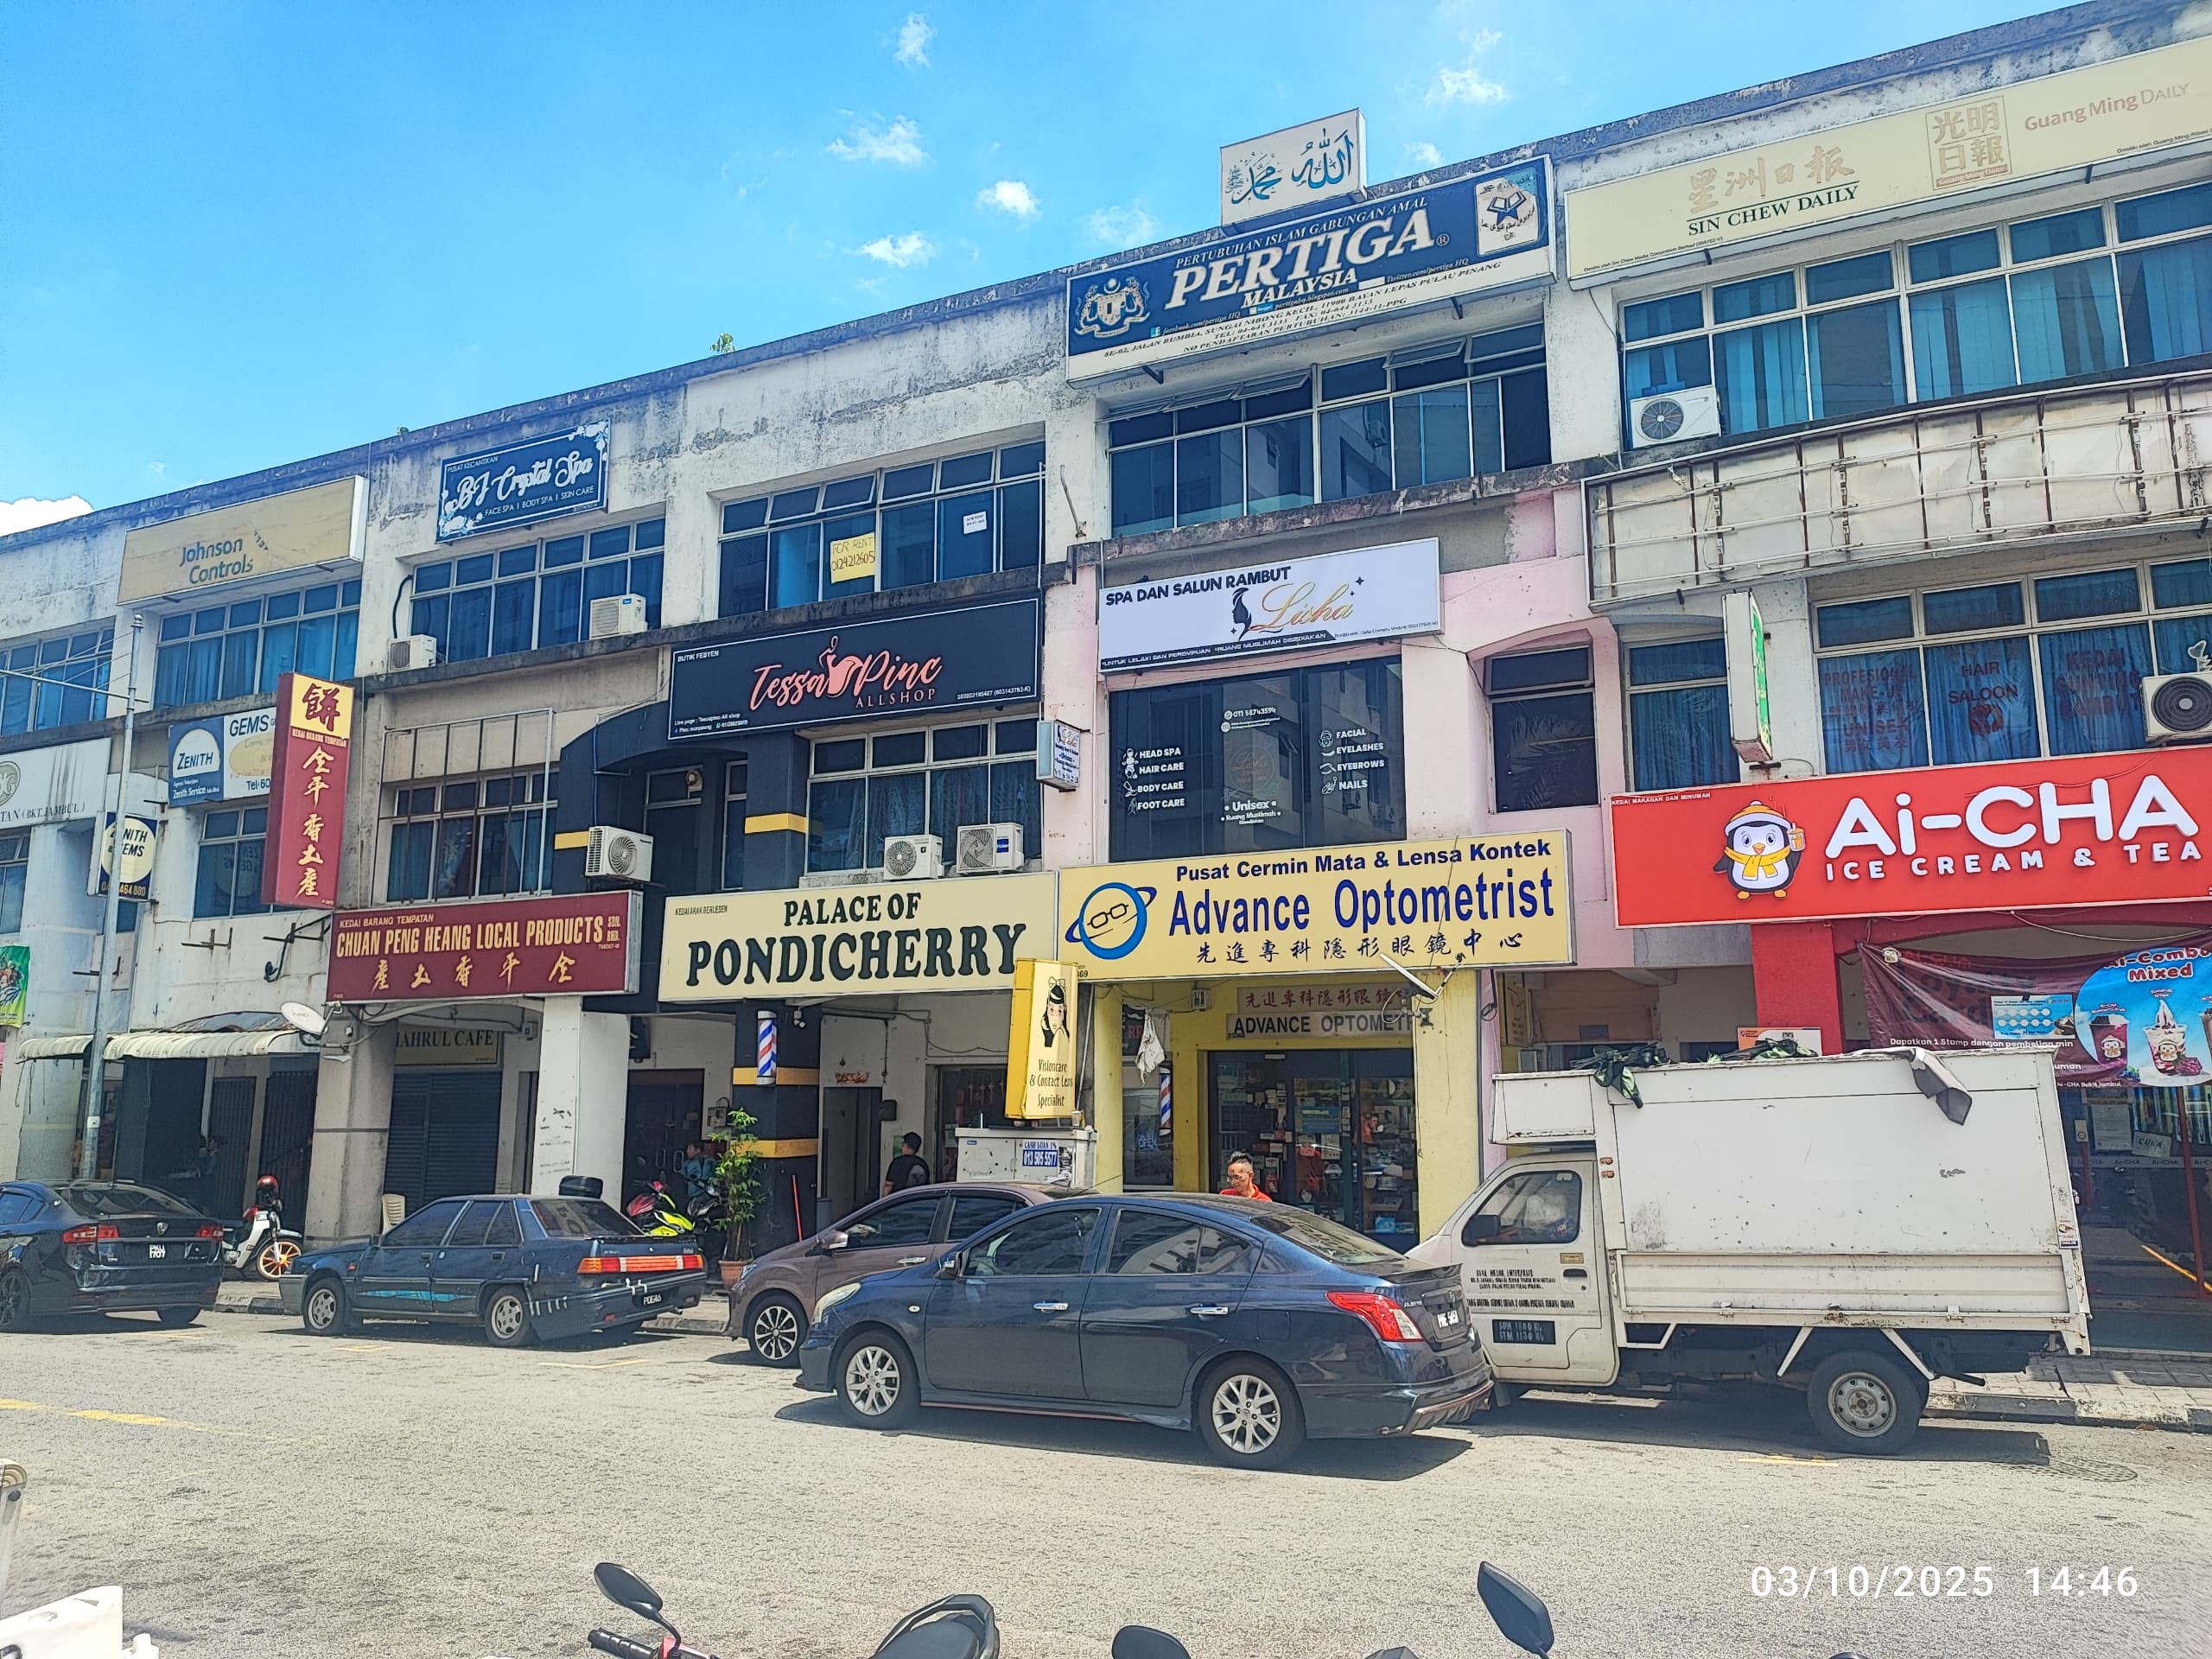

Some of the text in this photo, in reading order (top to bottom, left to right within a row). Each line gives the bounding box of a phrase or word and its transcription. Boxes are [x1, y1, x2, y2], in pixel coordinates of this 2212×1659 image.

[2024, 83, 2190, 130] Guang Ming DAILY
[1932, 102, 1999, 144] 光明
[1688, 185, 1859, 236] SIN CHEW DAILY
[1176, 196, 1428, 268] PERTUBUHAN ISLAM GABUNGAN AMAL
[1164, 209, 1435, 310] PERTIGA
[1455, 257, 1469, 267] HQ
[1241, 267, 1357, 309] MALAYSIA
[1131, 340, 1161, 352] JALAN
[1205, 321, 1244, 335] SUNGAI
[1245, 313, 1283, 327] NIBONG
[1348, 289, 1382, 302] BAYAN
[1384, 281, 1417, 295] LEPAS
[1420, 271, 1456, 287] PULAU
[1458, 261, 1503, 277] PINANG
[1184, 344, 1198, 353] NO
[491, 459, 553, 501] Crystal
[555, 451, 594, 488] Spa
[485, 486, 594, 517] FACE SPA BODY SPA SKIN CARE
[180, 536, 243, 568] Johnson
[833, 537, 874, 555] FOR RENT
[189, 554, 253, 585] Controls
[1105, 566, 1291, 607] SPA DAN SALUN RAMBUT
[1243, 638, 1281, 649] MUSLIMAH
[1282, 632, 1327, 643] DISEDIAKAN
[677, 653, 696, 663] BUTIK
[1961, 662, 2000, 677] HAIR
[749, 664, 830, 712] Tessa
[1948, 684, 2018, 704] SALOON
[855, 688, 937, 709] ALLSHOP
[229, 714, 270, 737] GEMS
[1336, 728, 1366, 739] FACIAL
[1139, 747, 1181, 760] HEAD SPA
[1336, 743, 1384, 754] EYELASHES
[177, 752, 213, 771] ZENITH
[1139, 761, 1184, 774] HAIR CARE
[1337, 760, 1384, 772] EYEBROWS
[188, 785, 207, 797] Service
[1137, 780, 1184, 793] BODY CARE
[1339, 779, 1368, 790] NAILS
[1137, 798, 1185, 810] FOOT CARE
[1232, 799, 1269, 812] Unisex
[1825, 774, 2199, 860] Ai-CHA
[1176, 839, 1552, 882] Pusat Cermin Mata & Lensa Kontek
[1826, 841, 2202, 881] ICE CREAM & TEA
[784, 892, 922, 927] PALACE OF
[1168, 867, 1555, 937] Advance Optometrist
[340, 913, 434, 929] KEDAI BARANG TEMPATAN
[336, 915, 604, 959] CHUAN PENG HEANG LOCAL PRODUCTS
[686, 923, 1027, 987] PONDICHERRY
[2128, 962, 2193, 982] Mixed
[1235, 1015, 1312, 1036] ADVANCE
[454, 1028, 494, 1046] CAFE
[1890, 1038, 1933, 1046] Dapatkan
[1941, 1038, 1968, 1047] Stamp
[1971, 1038, 2004, 1049] dengan
[1038, 1058, 1068, 1073] Visioncare
[1029, 1074, 1073, 1088] & Contact Lens
[1037, 1093, 1065, 1108] Specialist
